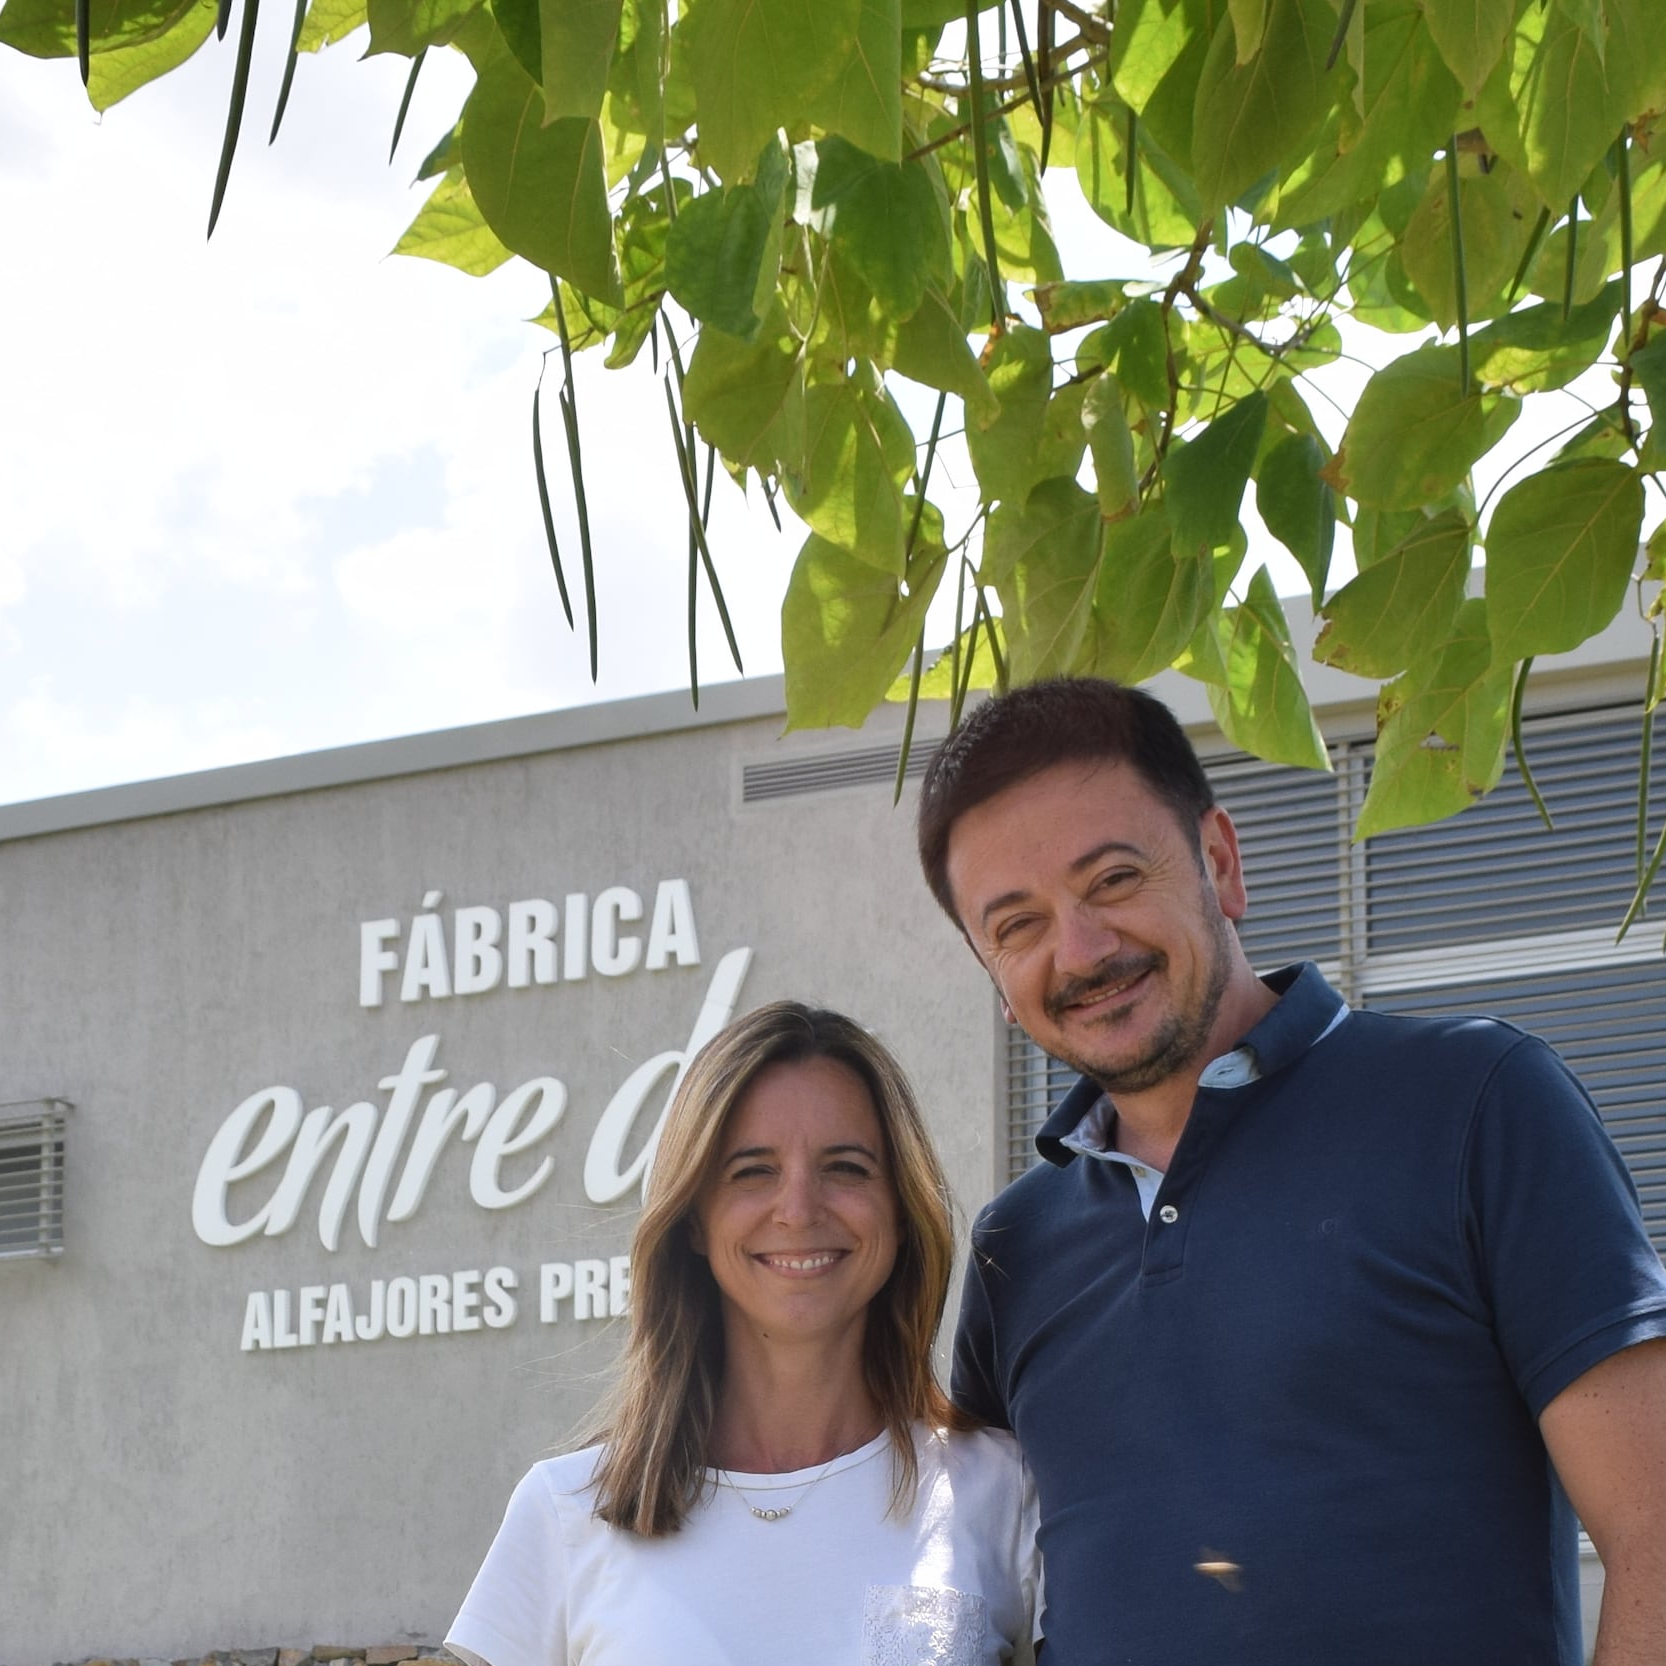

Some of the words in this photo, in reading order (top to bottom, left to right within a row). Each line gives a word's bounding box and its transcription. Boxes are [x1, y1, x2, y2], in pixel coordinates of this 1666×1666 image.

[359, 878, 701, 1008] FÁBRICA
[192, 1034, 568, 1252] entre
[240, 1265, 517, 1351] ALFAJORES
[540, 1255, 631, 1323] PRE
